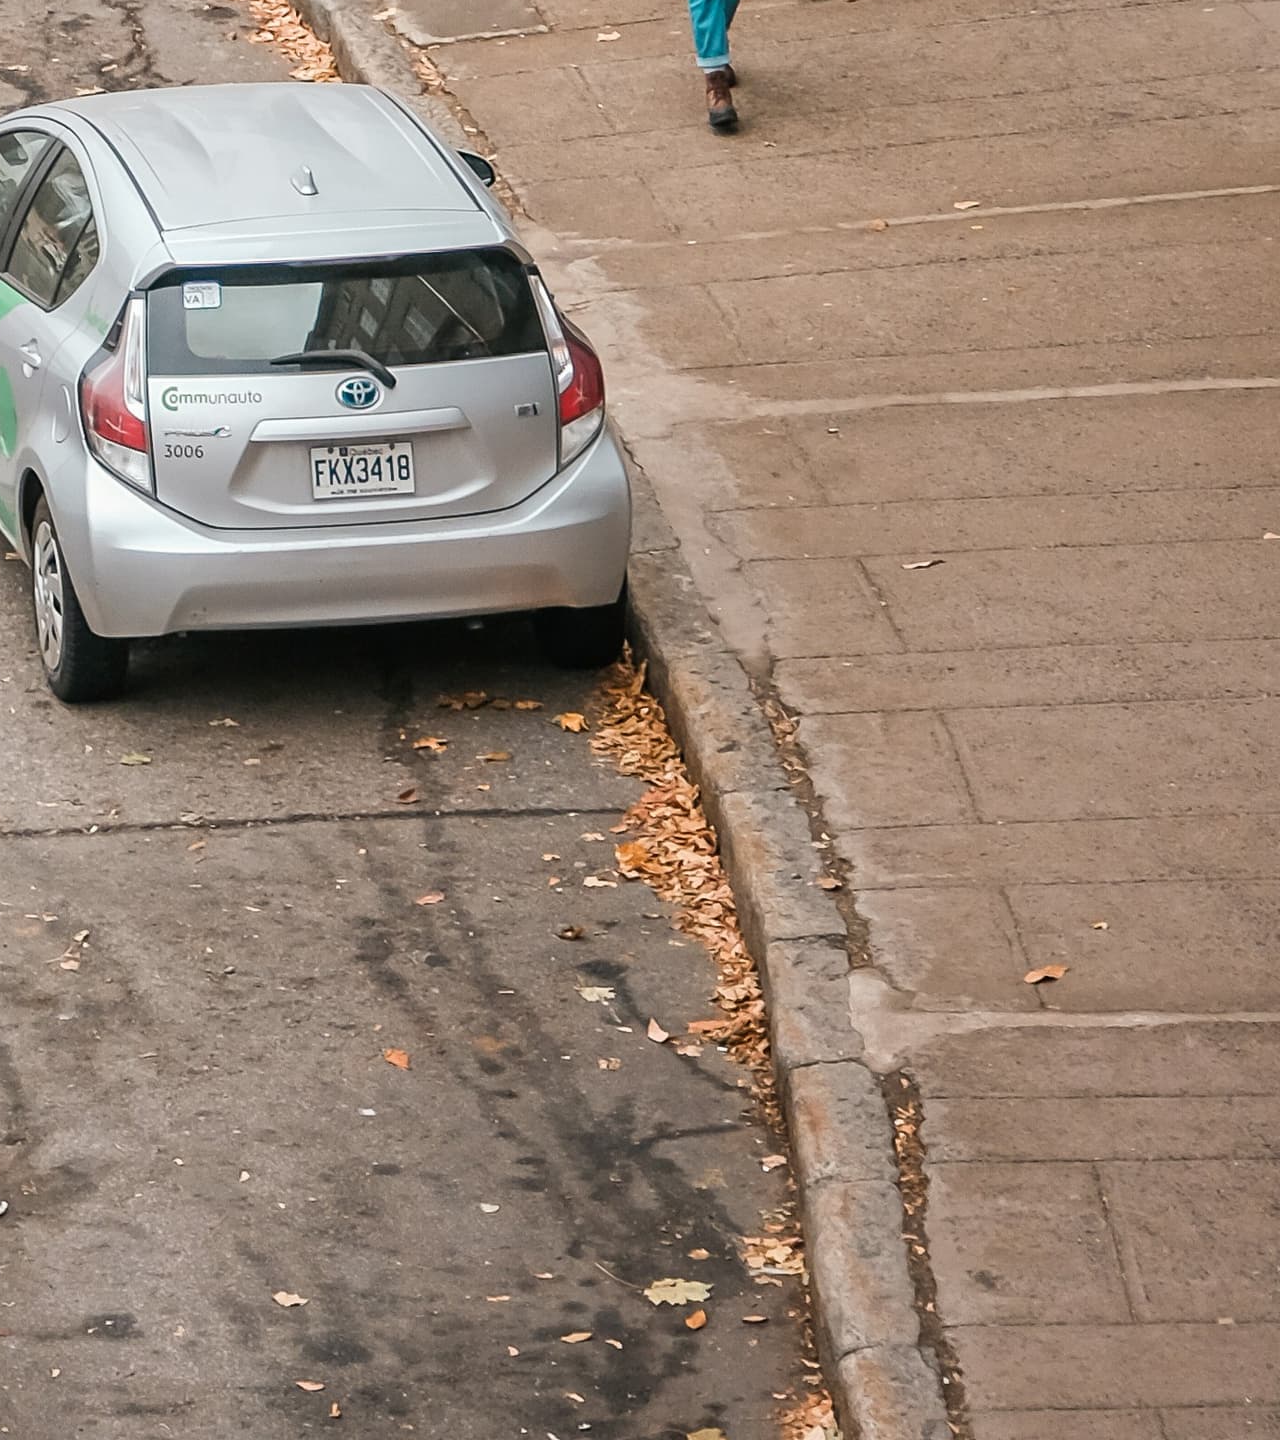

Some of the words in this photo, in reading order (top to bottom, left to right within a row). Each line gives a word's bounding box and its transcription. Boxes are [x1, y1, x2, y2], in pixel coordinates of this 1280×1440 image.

[161, 386, 263, 412] Communauto
[163, 443, 205, 459] 3006
[314, 453, 411, 487] FKX3418
